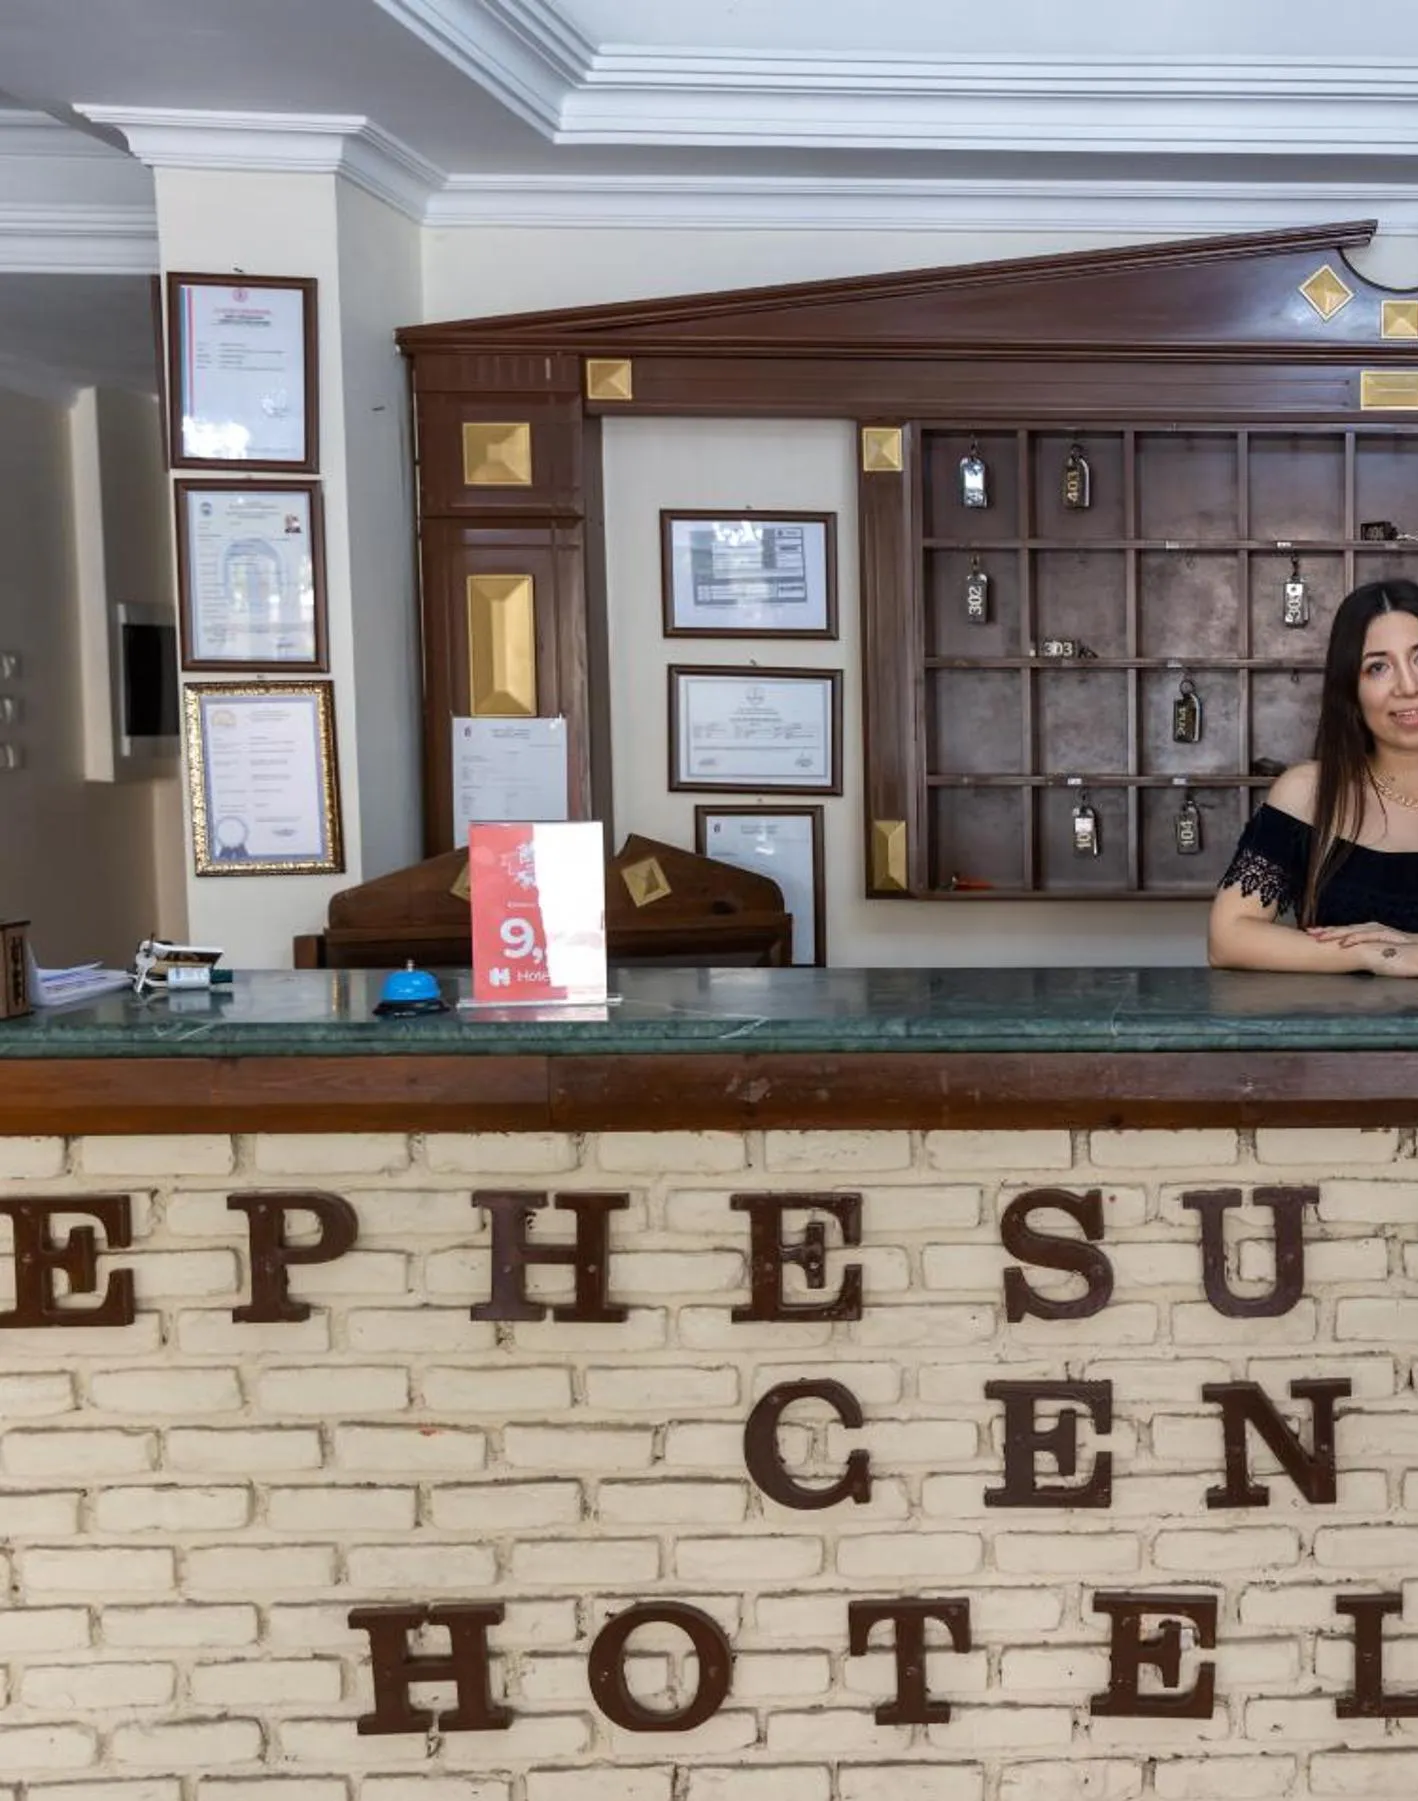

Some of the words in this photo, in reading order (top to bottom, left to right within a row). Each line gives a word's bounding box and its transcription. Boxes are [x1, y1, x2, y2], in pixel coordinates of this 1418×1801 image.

[967, 585, 982, 615] 302
[1043, 641, 1073, 657] 303
[1180, 820, 1195, 845] 104
